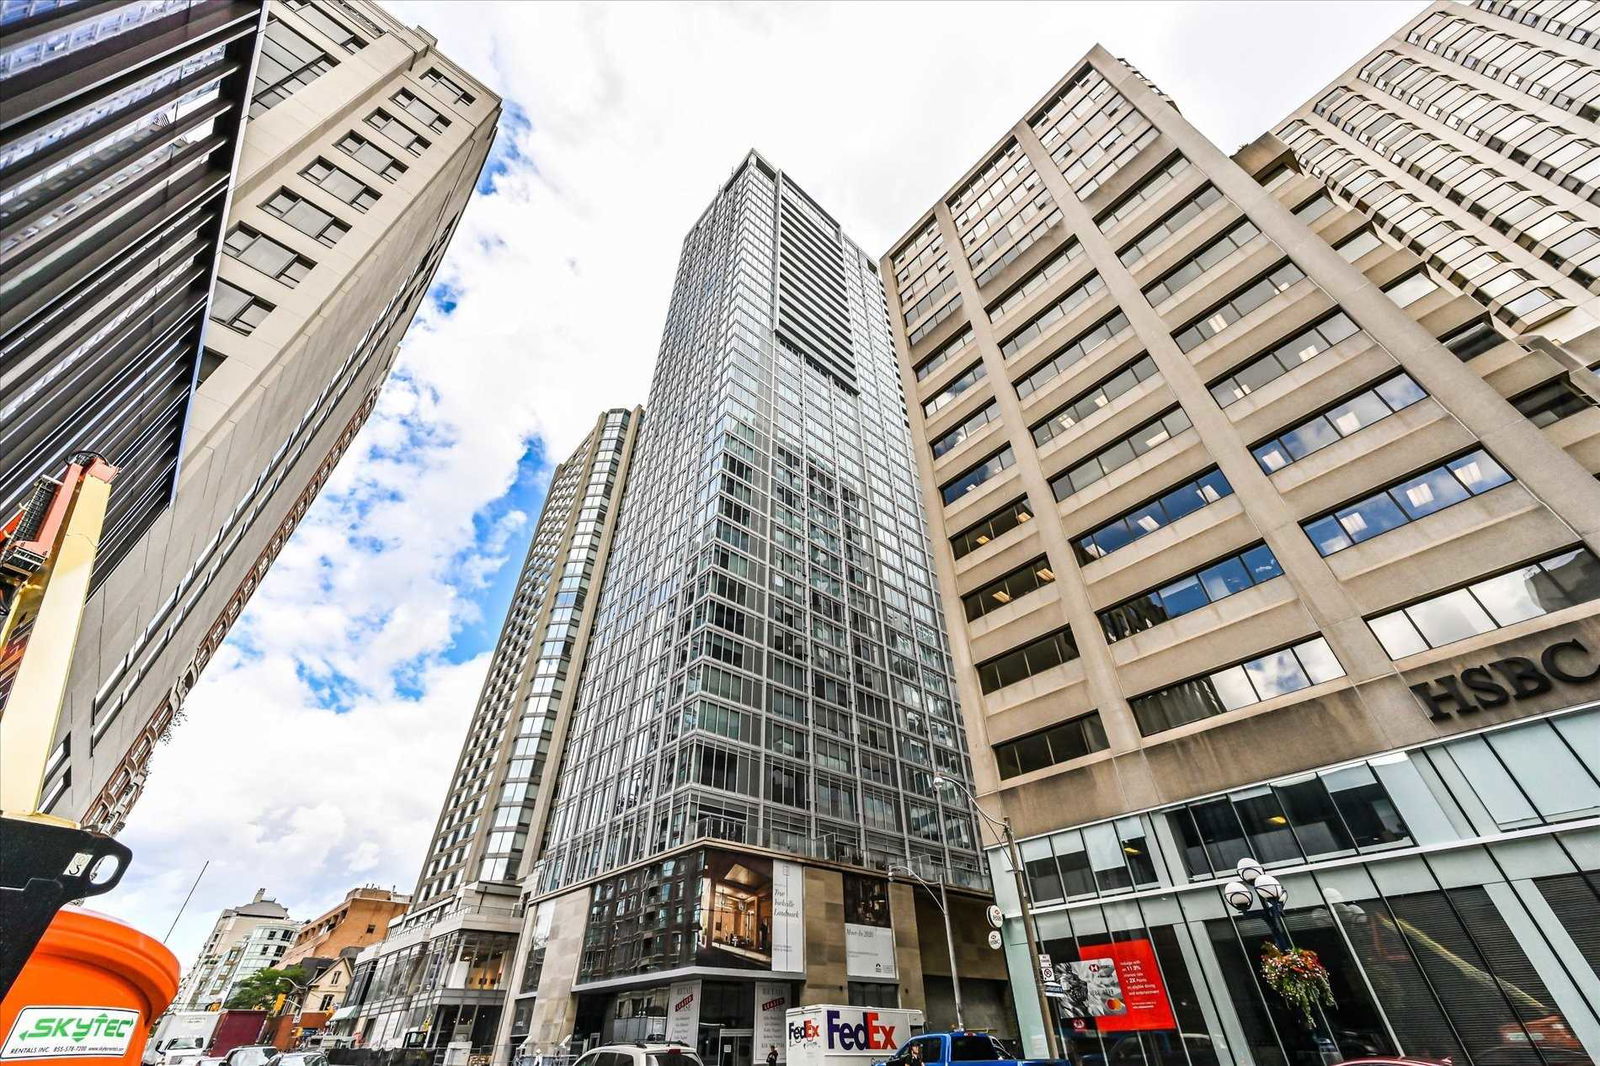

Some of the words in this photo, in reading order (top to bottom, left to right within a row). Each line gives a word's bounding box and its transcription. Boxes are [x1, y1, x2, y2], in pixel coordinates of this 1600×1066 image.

[1409, 638, 1600, 721] HSBC
[676, 995, 693, 1011] LEASED
[763, 998, 784, 1011] LEASED
[20, 1014, 133, 1041] SKYTEC
[788, 1019, 820, 1041] FedEx
[827, 1010, 897, 1051] FedEx
[10, 1046, 37, 1054] RENTALS
